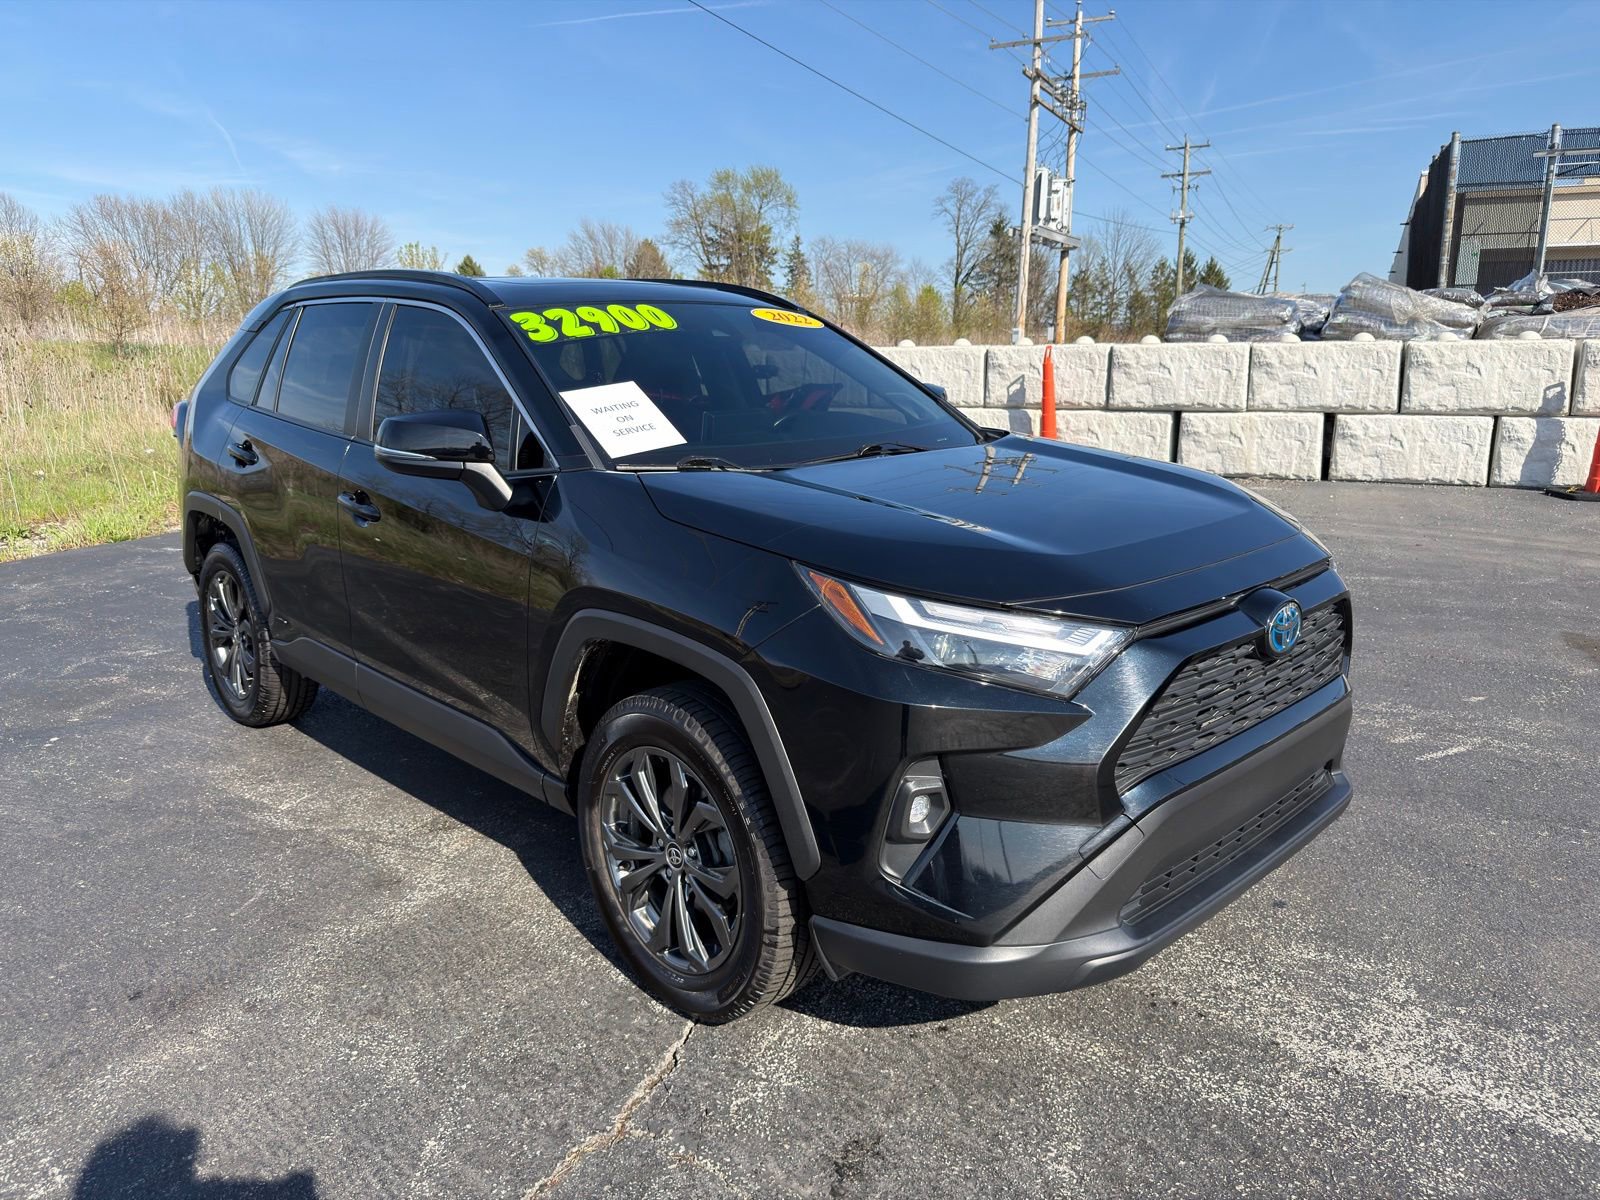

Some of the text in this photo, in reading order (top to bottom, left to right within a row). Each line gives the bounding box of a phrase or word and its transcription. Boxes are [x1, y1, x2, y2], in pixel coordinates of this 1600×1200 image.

[509, 303, 678, 342] 32900
[765, 310, 813, 325] 2022
[590, 400, 639, 416] WAITING
[616, 413, 634, 423] ON
[612, 422, 656, 437] SERVICE
